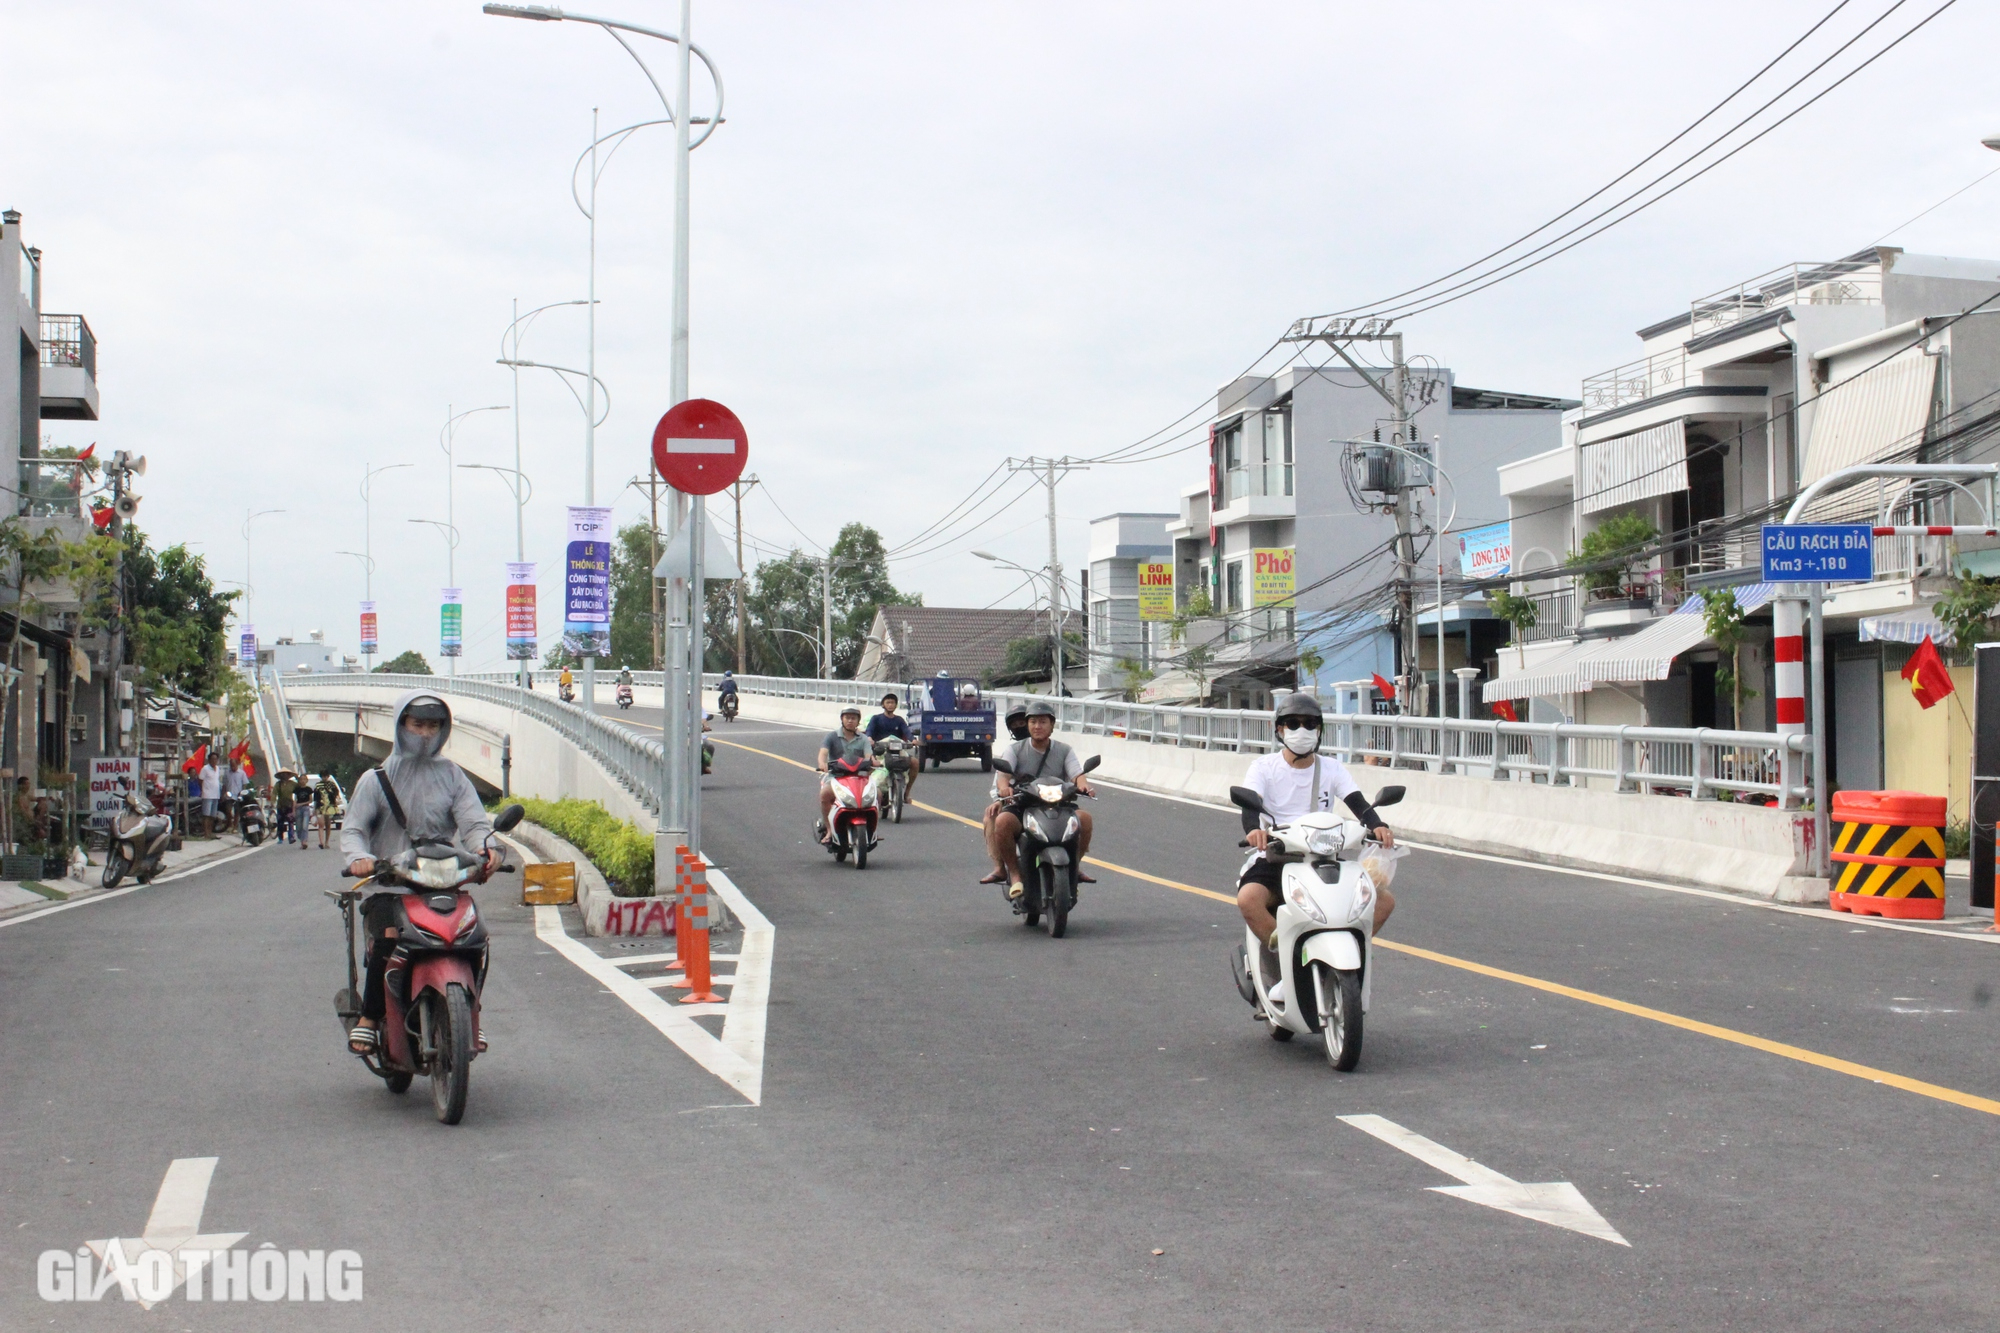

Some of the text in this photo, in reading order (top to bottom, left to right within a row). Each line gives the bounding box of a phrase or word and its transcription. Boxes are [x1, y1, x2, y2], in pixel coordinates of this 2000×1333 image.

[574, 523, 599, 531] TCIP
[1766, 530, 1869, 553] CẦU RẠCH ĐỈA
[1255, 549, 1292, 573] Phở
[1471, 550, 1492, 567] LONG
[571, 559, 605, 570] THÔNG XE
[1148, 564, 1163, 573] 60
[568, 573, 607, 584] CÔNG TRÌNH
[1140, 574, 1172, 585] LINH
[571, 586, 584, 596] XÂY
[570, 598, 581, 609] CẦU
[97, 760, 130, 775] NHẬN
[91, 779, 118, 794] GIẶT
